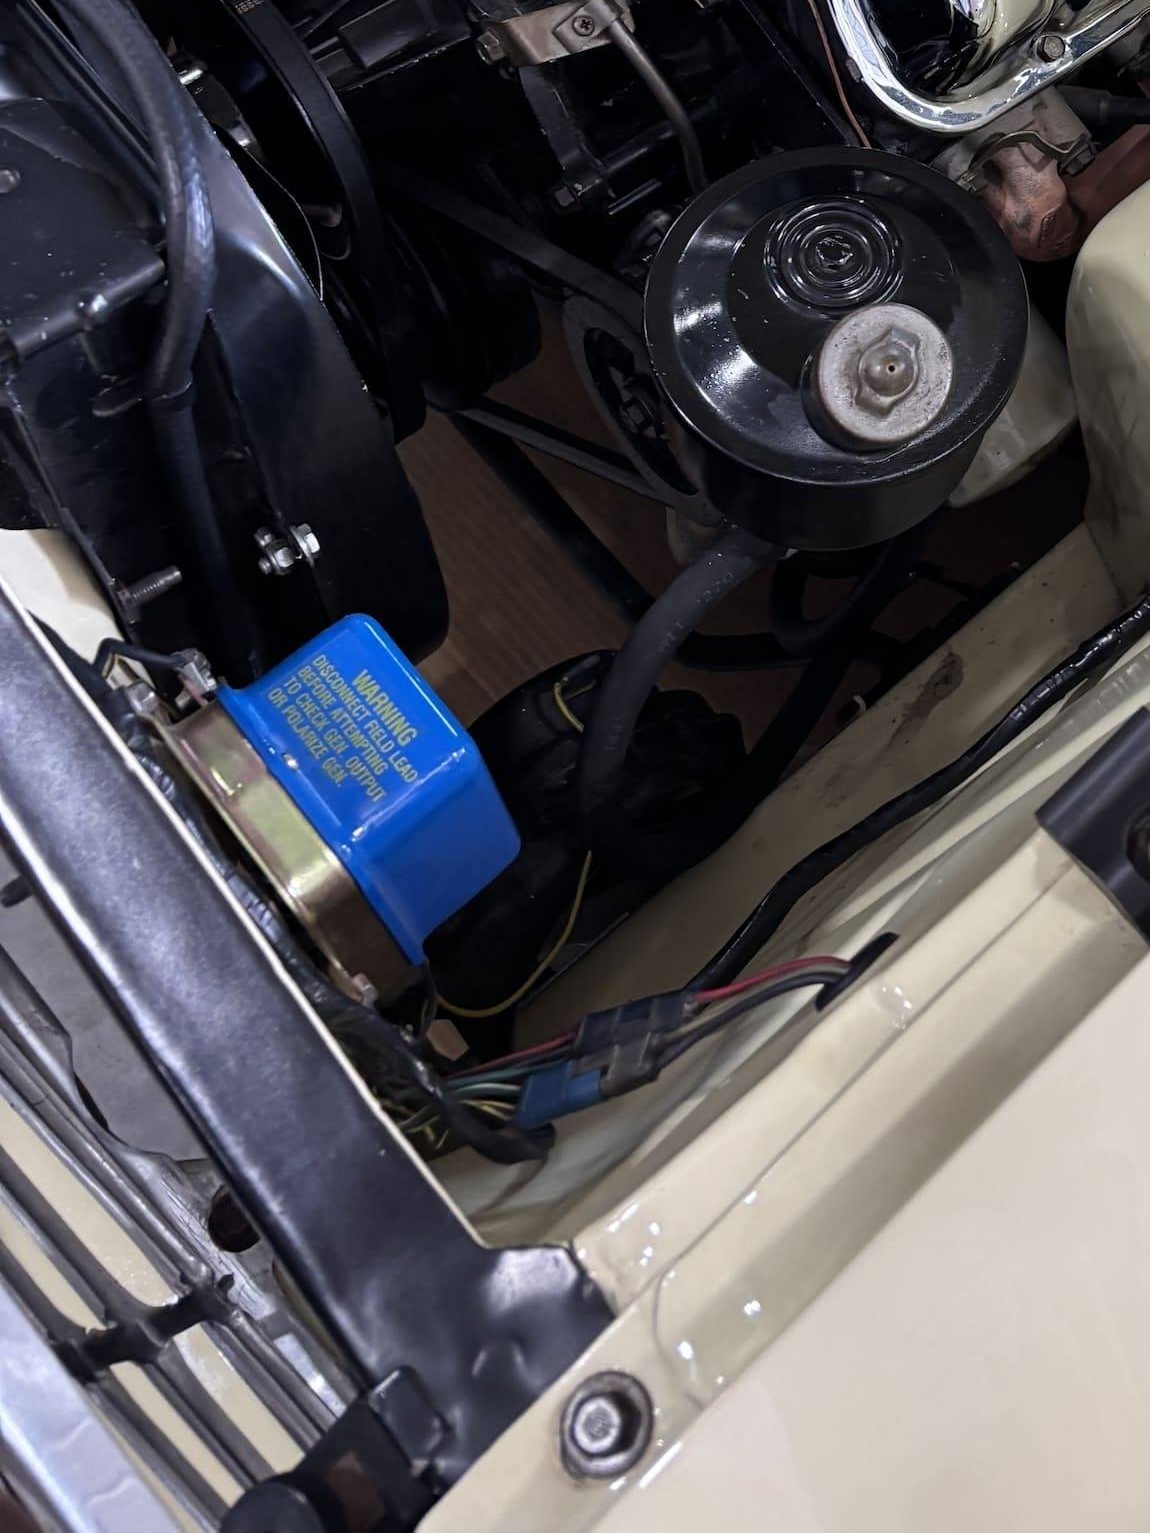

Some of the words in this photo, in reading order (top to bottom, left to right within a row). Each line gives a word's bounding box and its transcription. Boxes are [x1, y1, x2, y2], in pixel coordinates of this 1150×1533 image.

[268, 687, 289, 708] OR
[281, 703, 330, 760] POLARIZE
[322, 755, 350, 787] GEN.
[283, 676, 302, 696] TO
[296, 691, 331, 731] CHECK
[344, 755, 389, 803] OUTPUT
[297, 665, 337, 711] BEFORE
[330, 708, 389, 777] ATTEMPTING
[312, 654, 371, 722] DISCONNECT
[363, 719, 395, 754] FIELD
[388, 750, 418, 784] LEAD
[351, 669, 417, 747] WARNING
